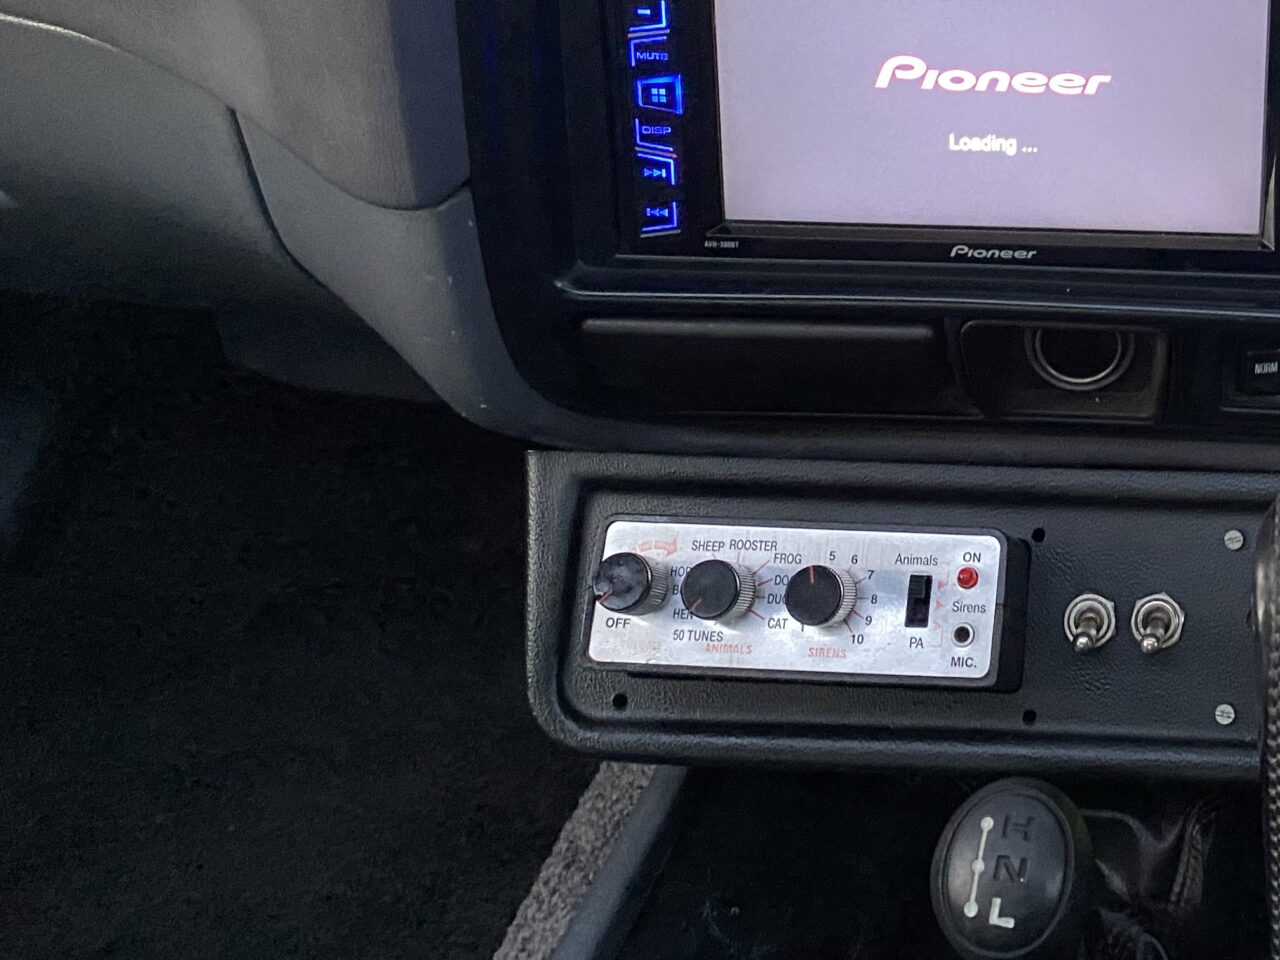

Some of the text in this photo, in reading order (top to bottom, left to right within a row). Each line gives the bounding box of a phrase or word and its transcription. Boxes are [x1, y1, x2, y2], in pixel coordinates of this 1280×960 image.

[636, 51, 668, 61] MUTE
[874, 55, 1112, 95] Pioneer
[641, 126, 672, 135] DISP
[949, 133, 1017, 156] Loading
[950, 244, 1037, 259] Pioneer
[1254, 361, 1279, 374] NORM
[691, 539, 778, 552] SHEEP ROOSTER
[773, 553, 802, 564] FROG
[829, 551, 836, 561] 5
[851, 554, 858, 565] 6
[894, 553, 938, 566] Animals
[962, 552, 982, 563] ON
[671, 566, 692, 577] HO
[867, 570, 875, 580] 7
[774, 575, 789, 586] DO
[870, 594, 878, 604] 8
[952, 601, 986, 614] Sirens
[605, 617, 631, 629] OFF
[767, 618, 788, 629] CAT
[865, 615, 872, 626] 9
[673, 629, 724, 642] 50 TUNES
[851, 634, 864, 645] 10
[704, 643, 752, 654] ANIMALS
[909, 637, 924, 649] PA
[808, 647, 847, 659] SIRENS
[950, 656, 977, 668] MIC.
[1002, 814, 1035, 841] H
[993, 854, 1030, 882] N
[989, 897, 1015, 929] L
